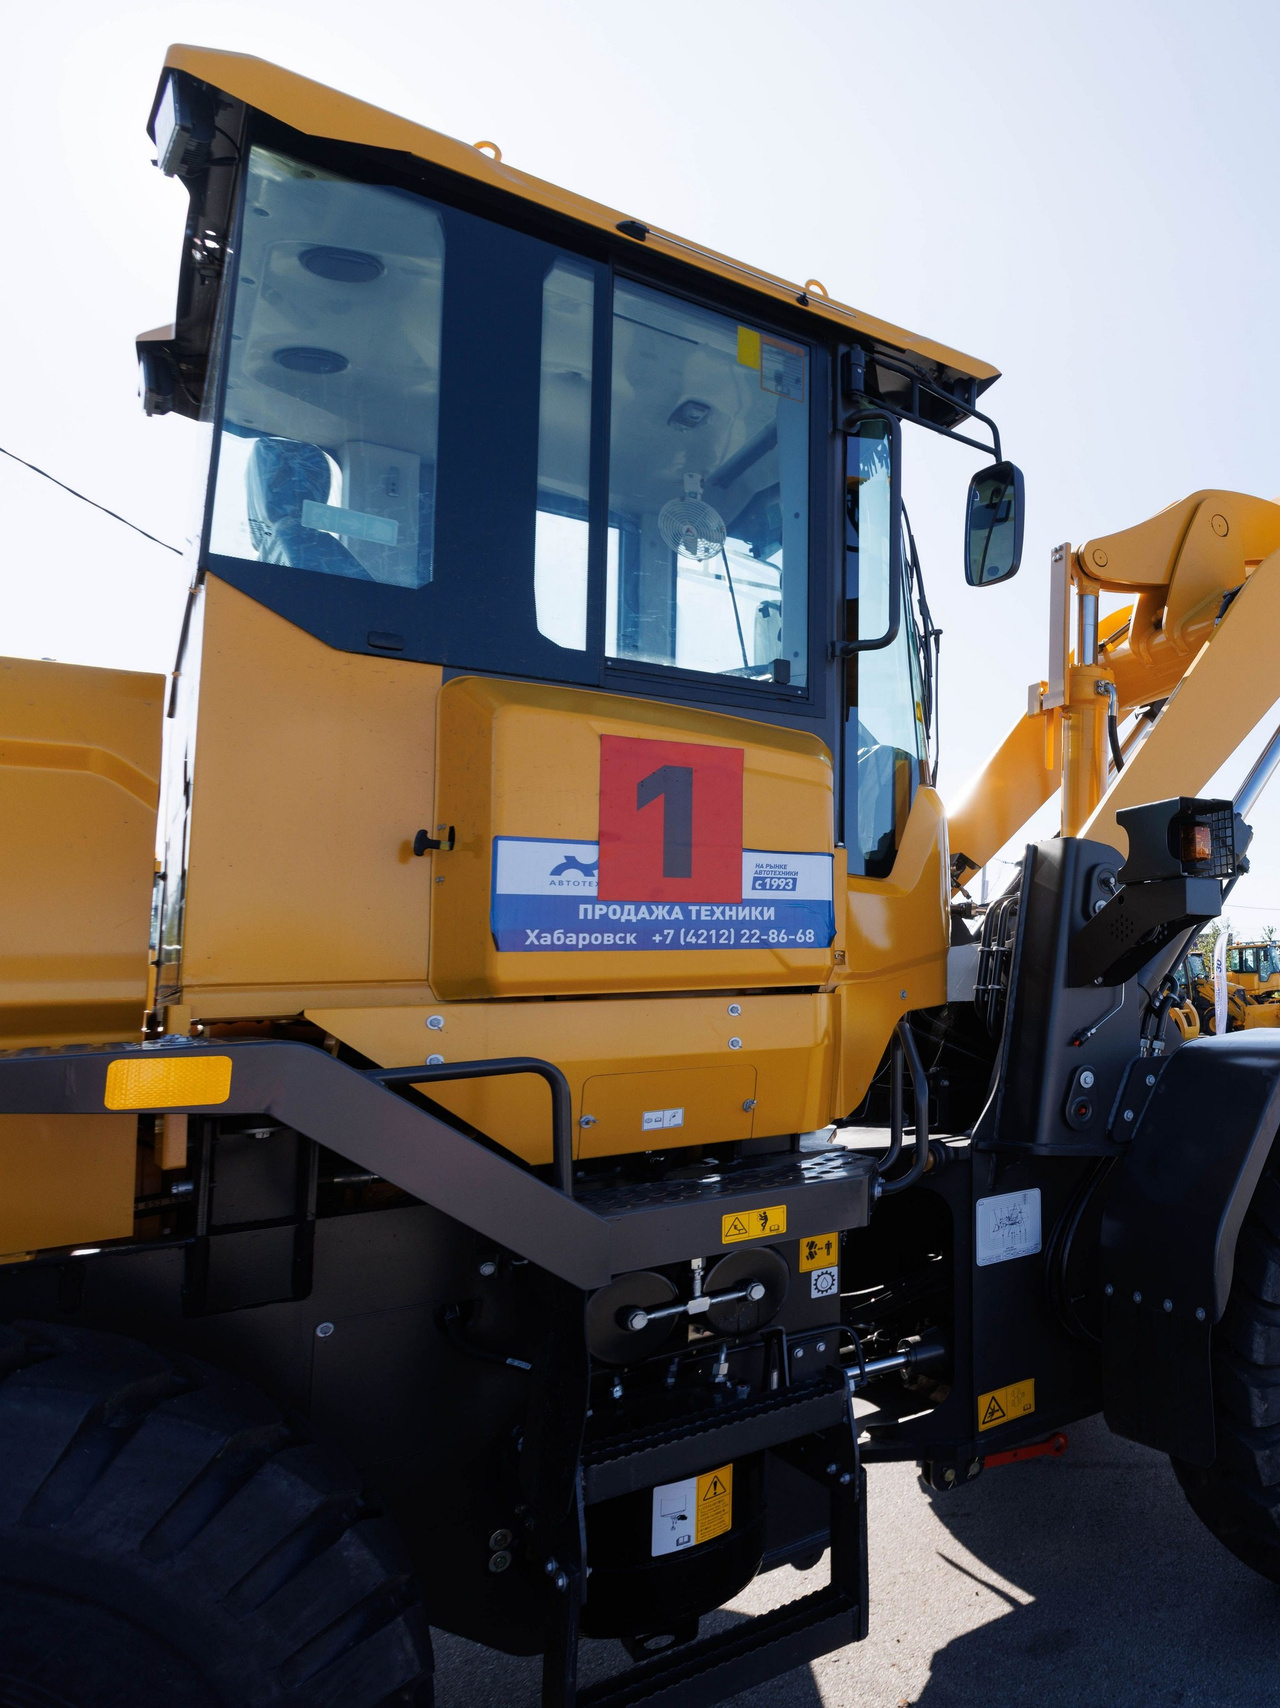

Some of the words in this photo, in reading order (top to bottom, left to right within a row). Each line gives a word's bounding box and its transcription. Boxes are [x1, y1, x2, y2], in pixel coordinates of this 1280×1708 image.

[636, 764, 694, 879] 1
[764, 878, 793, 890] 1993
[578, 904, 684, 922] ПРОДАЖА
[688, 905, 776, 921] ТЕХНИКИ
[524, 929, 638, 948] Хабаровск
[652, 929, 675, 945] +7
[680, 929, 735, 946] (4212)
[740, 929, 816, 945] 22-86-68
